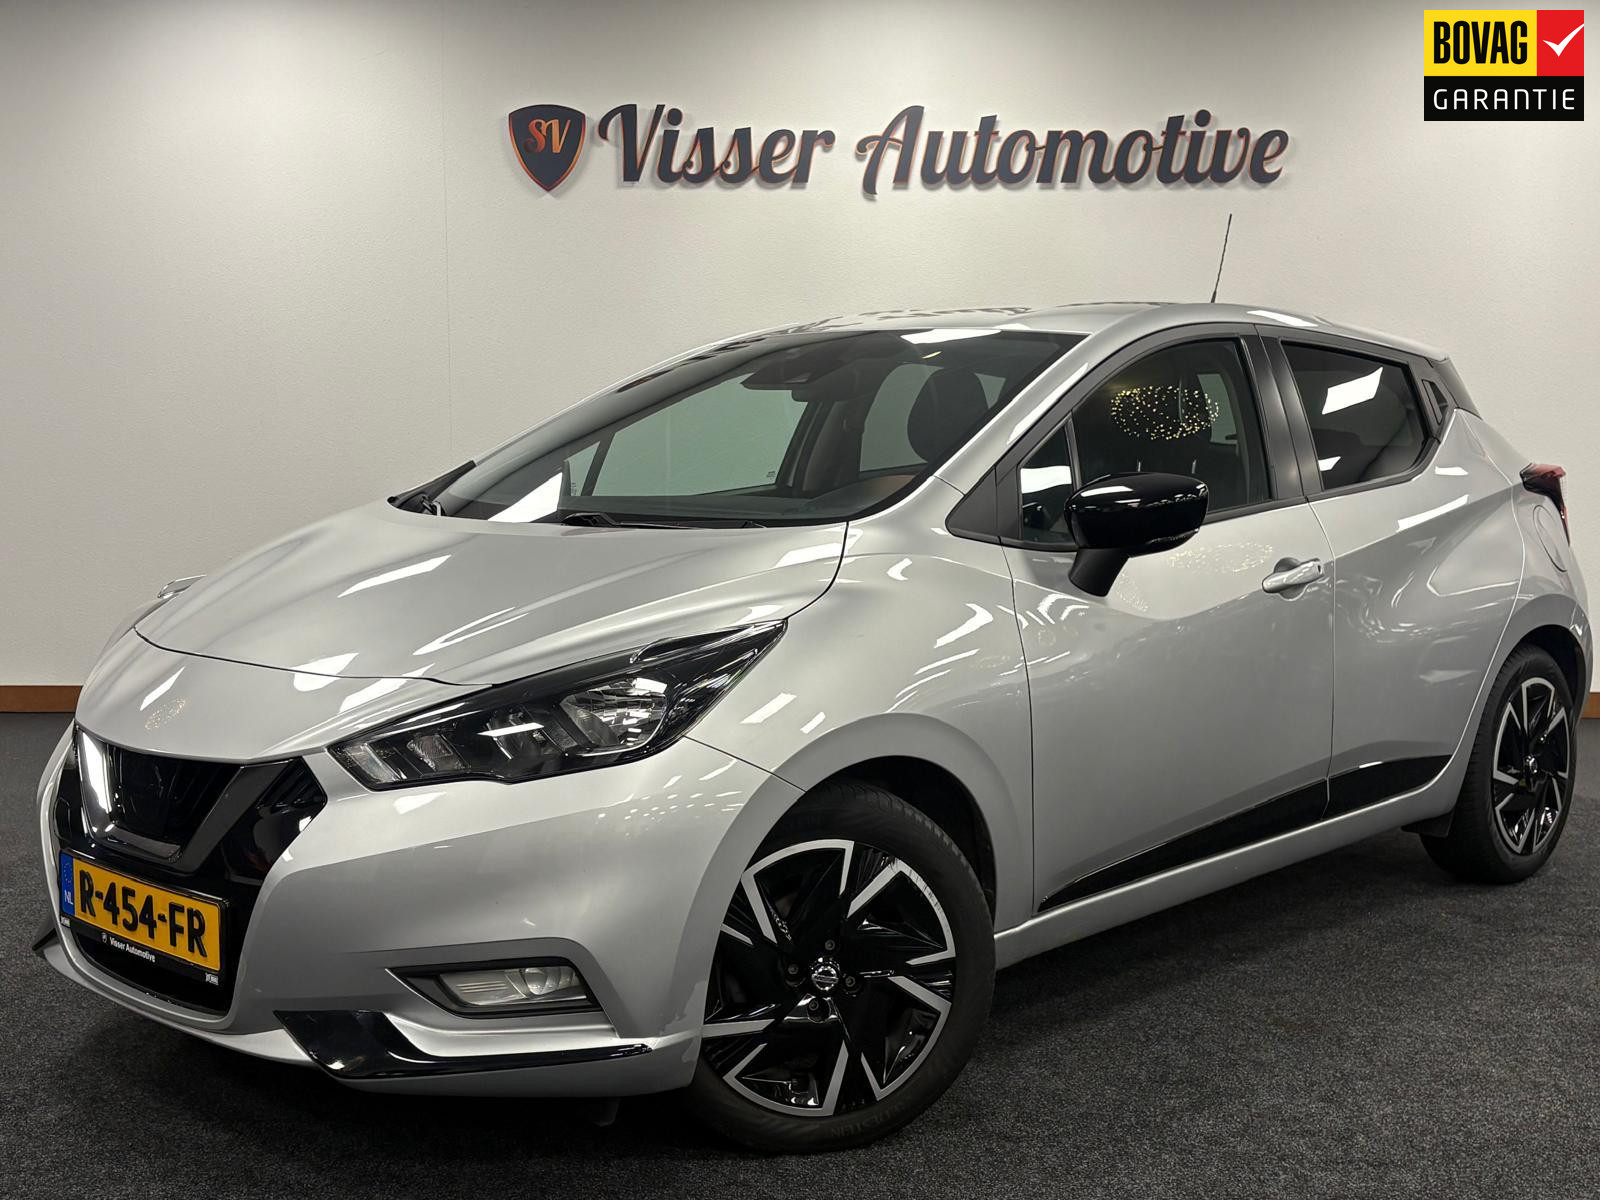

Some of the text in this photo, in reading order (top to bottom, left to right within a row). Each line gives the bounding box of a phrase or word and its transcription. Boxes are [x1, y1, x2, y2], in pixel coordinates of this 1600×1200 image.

[523, 118, 571, 154] SV
[597, 103, 1290, 196] Visser Automotive
[64, 887, 74, 905] NL
[79, 869, 208, 958] R-454-FR
[109, 933, 156, 963] Visser Automotive
